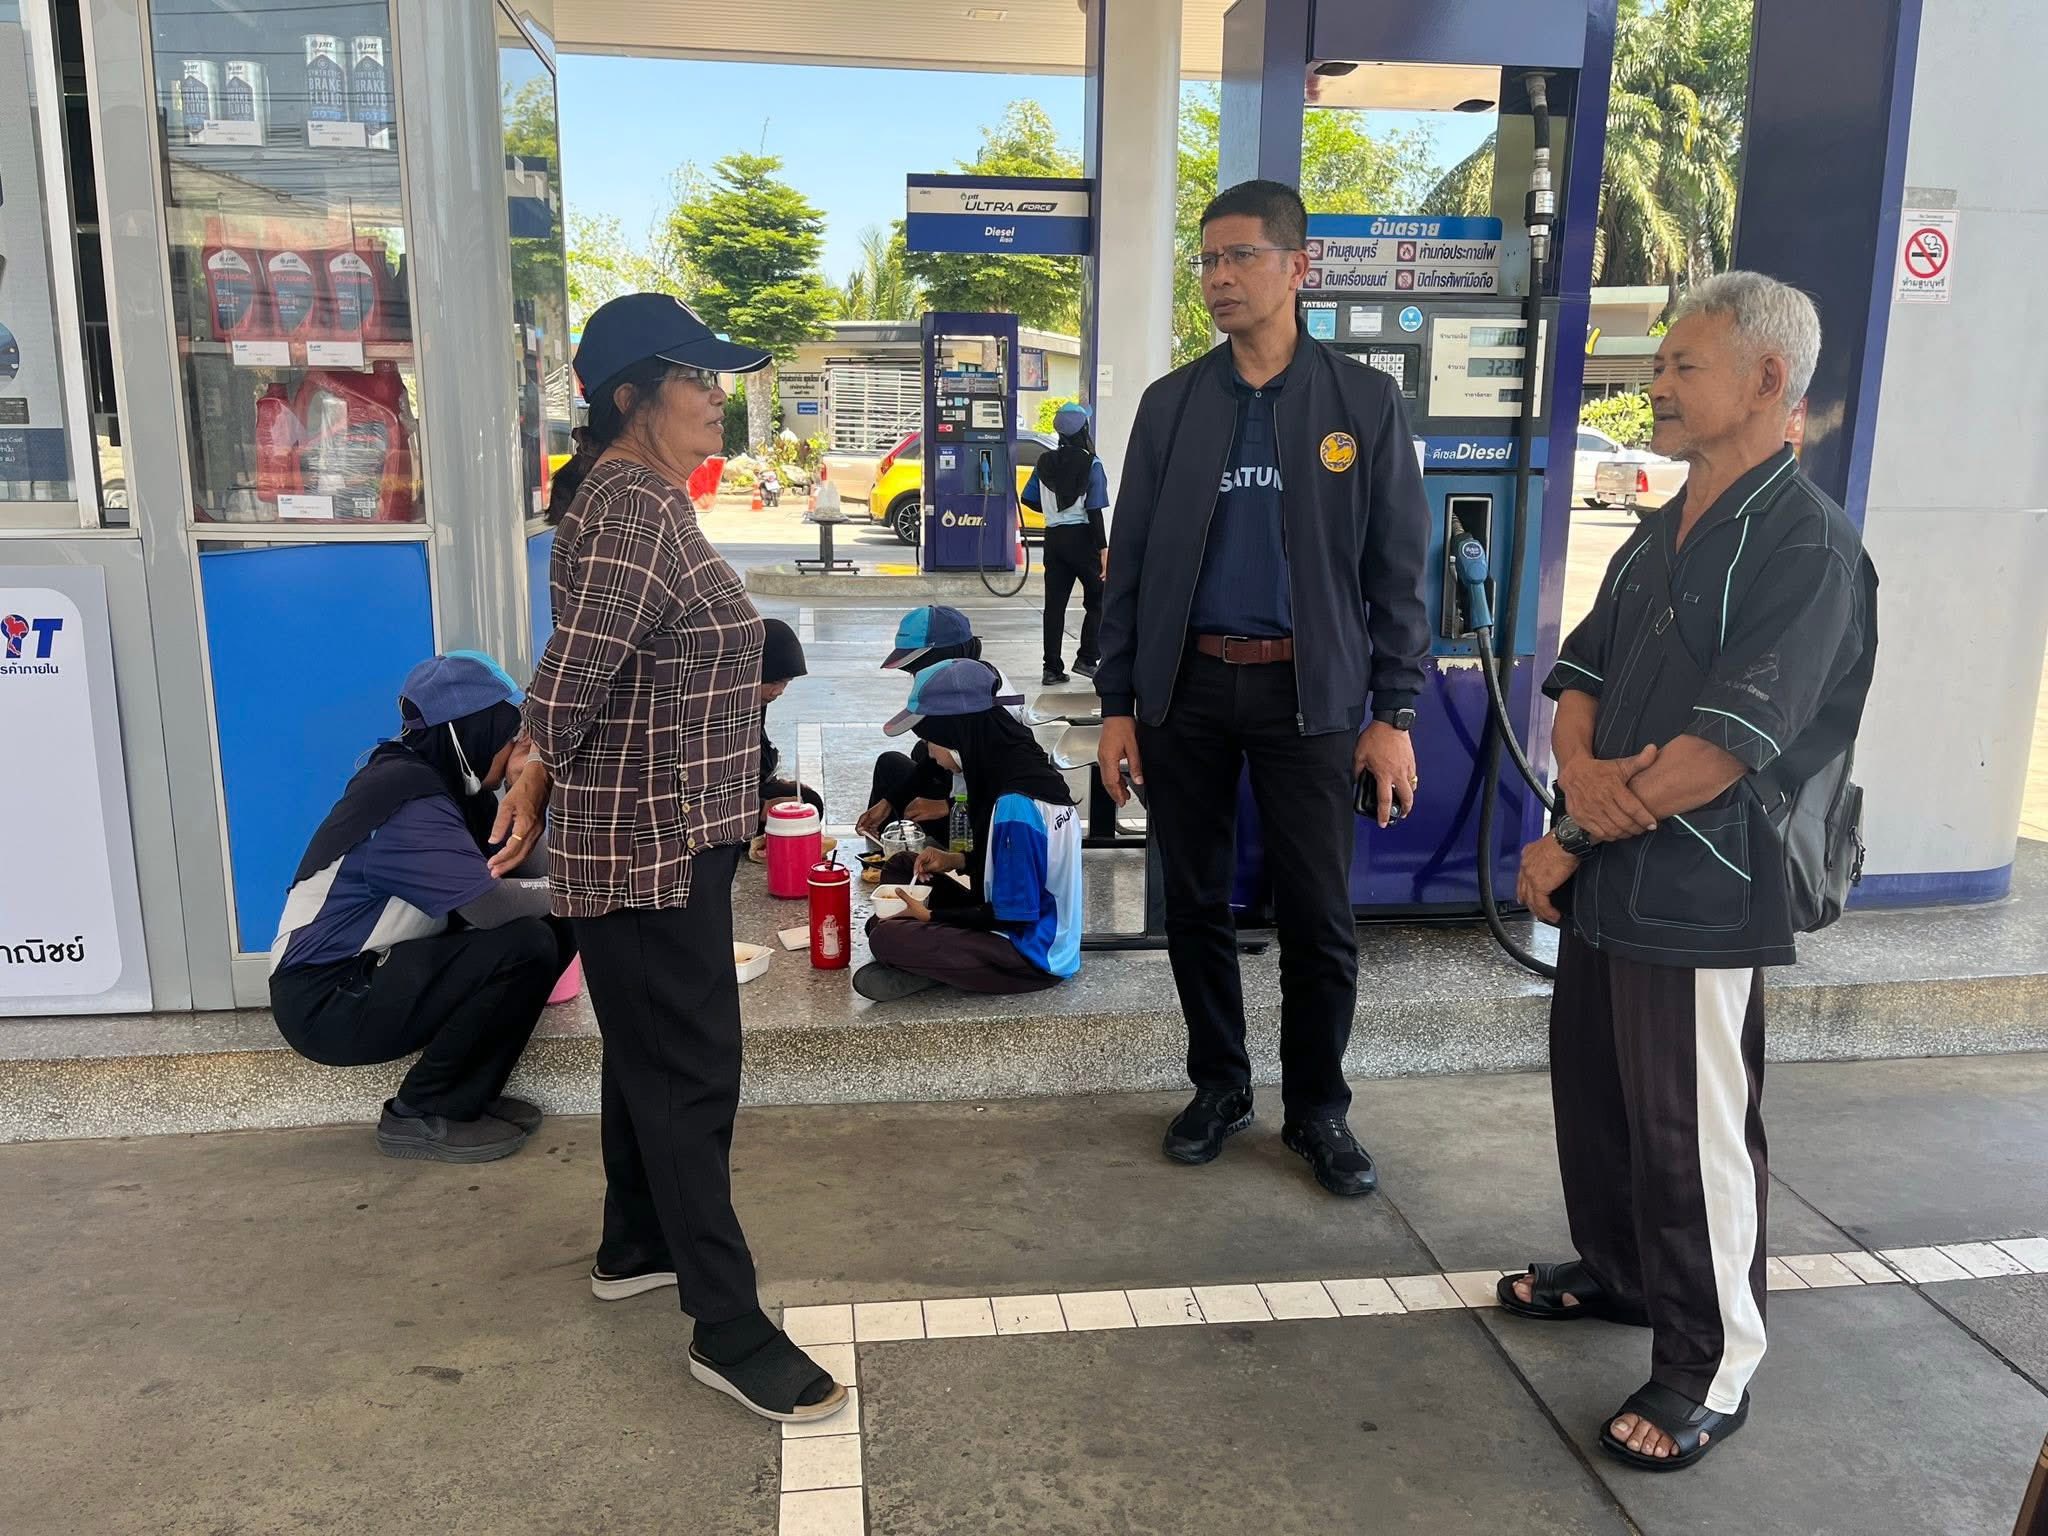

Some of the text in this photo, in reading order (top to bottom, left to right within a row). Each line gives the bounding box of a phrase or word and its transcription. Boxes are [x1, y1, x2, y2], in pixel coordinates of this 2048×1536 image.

[308, 78, 342, 92] BRAKE
[309, 92, 343, 105] FLUID
[965, 201, 1053, 212] ULTRA FORCE
[985, 226, 1015, 237] Diesel
[1370, 217, 1440, 236] อันตราย
[1326, 239, 1496, 262] ห้ามสูบบุหรี่ ห้ามก่อประกายไฟ
[1325, 267, 1493, 288] ดับเครื่องยนต์ ปิดโทรศัพท์มือถือ
[1456, 442, 1513, 460] Diesel
